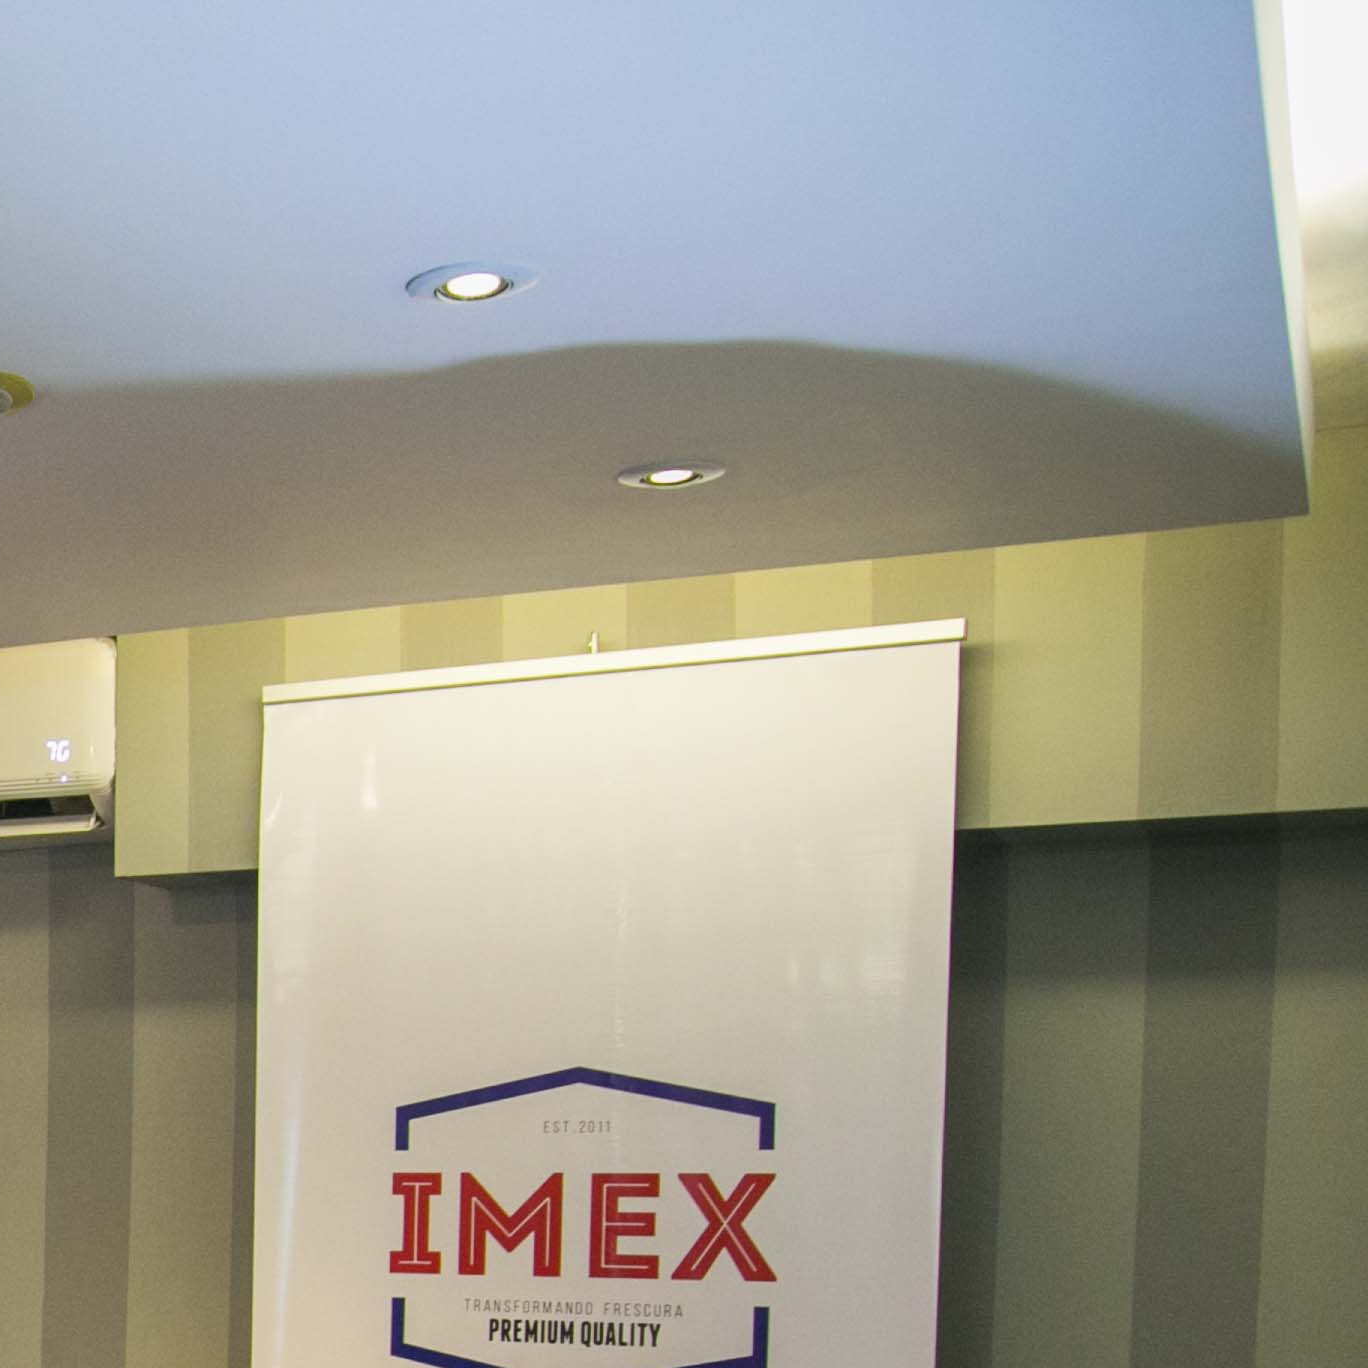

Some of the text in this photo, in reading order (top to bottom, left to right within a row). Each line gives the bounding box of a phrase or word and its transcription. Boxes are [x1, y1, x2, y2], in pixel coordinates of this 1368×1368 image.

[389, 1171, 778, 1282] IMEX
[464, 1298, 684, 1318] TRANSFORMANDO FRESCURA
[488, 1318, 662, 1348] PREMIUM QUALITY
